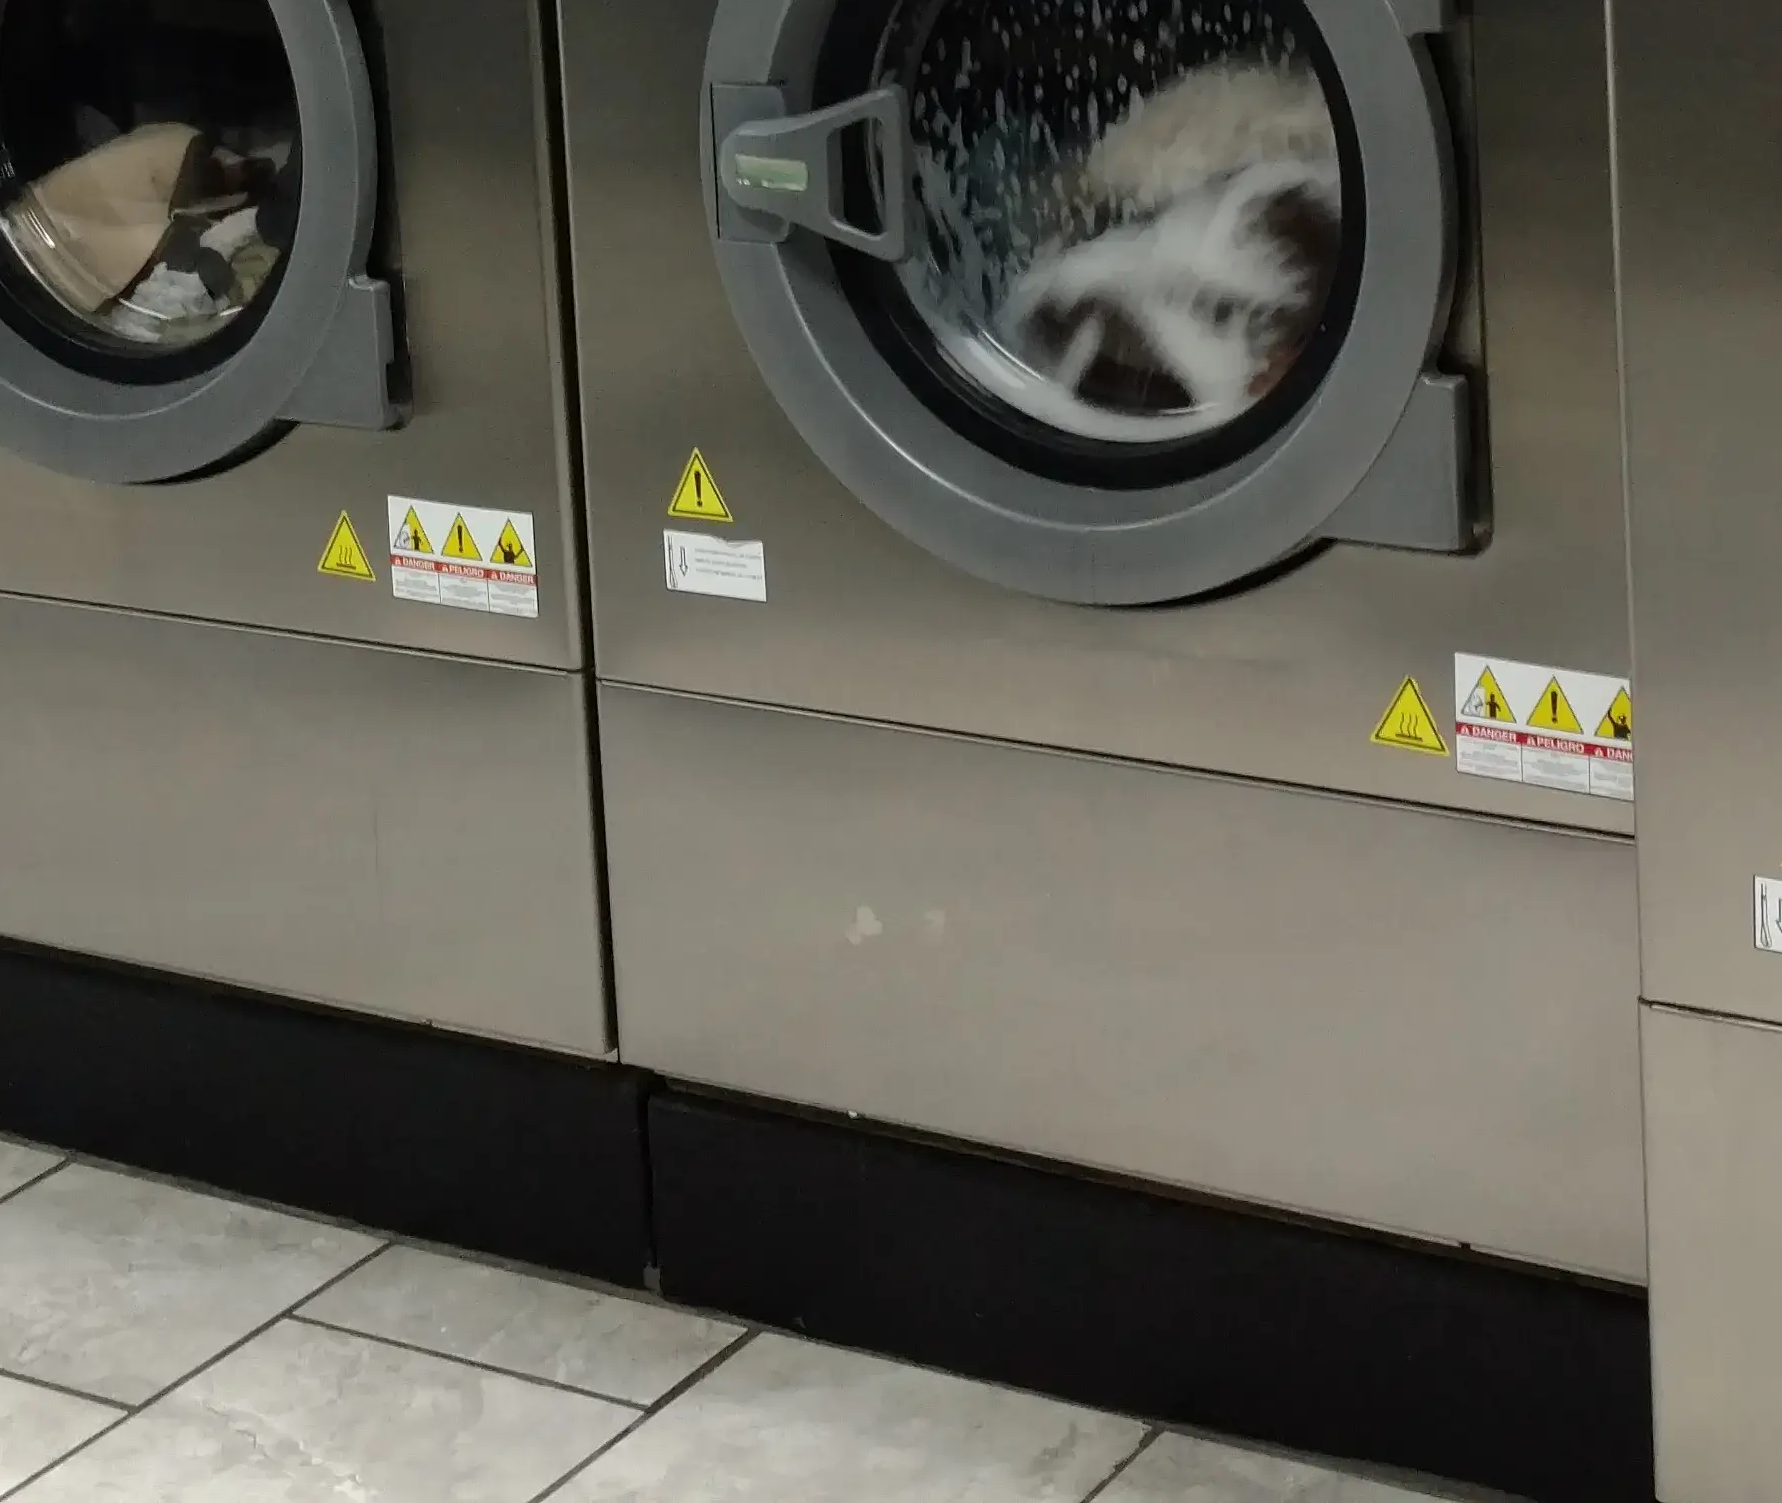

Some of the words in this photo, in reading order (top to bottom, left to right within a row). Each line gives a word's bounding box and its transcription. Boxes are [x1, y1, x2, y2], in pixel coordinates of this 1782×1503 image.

[402, 557, 437, 572] DANGER
[448, 564, 485, 578] PELIGRO
[499, 571, 535, 585] DANGER
[1472, 726, 1517, 743] DANGER
[1536, 735, 1585, 754] PELIGRO
